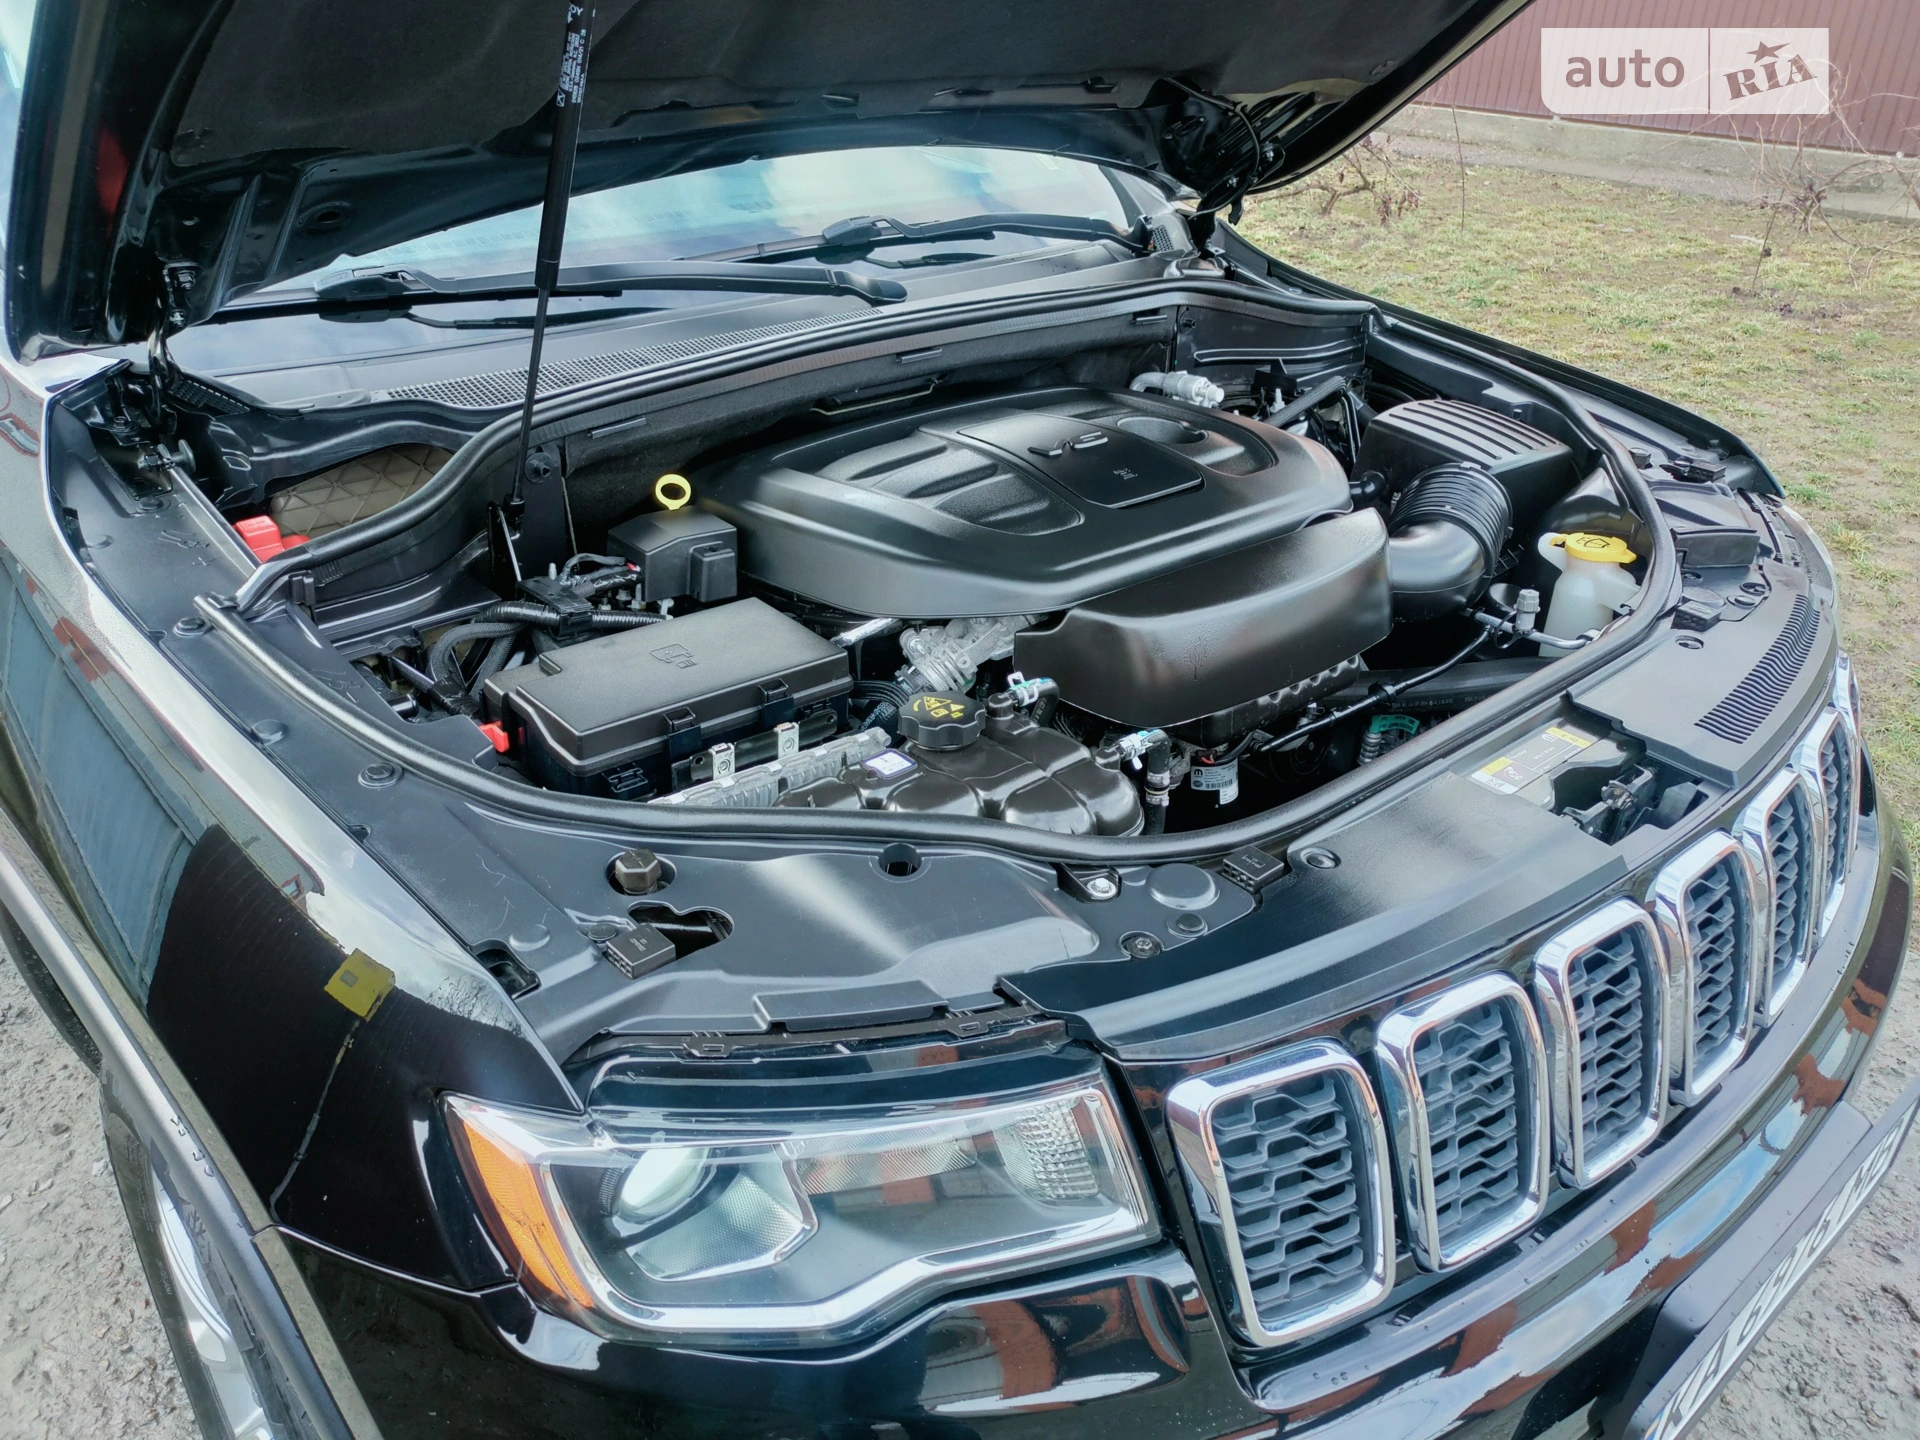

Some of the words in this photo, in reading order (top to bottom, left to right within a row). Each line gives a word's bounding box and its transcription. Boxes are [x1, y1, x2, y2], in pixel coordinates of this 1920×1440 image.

[1659, 1328, 1730, 1440] KA
[1736, 1190, 1841, 1347] 6976
[1836, 1116, 1904, 1225] MB
